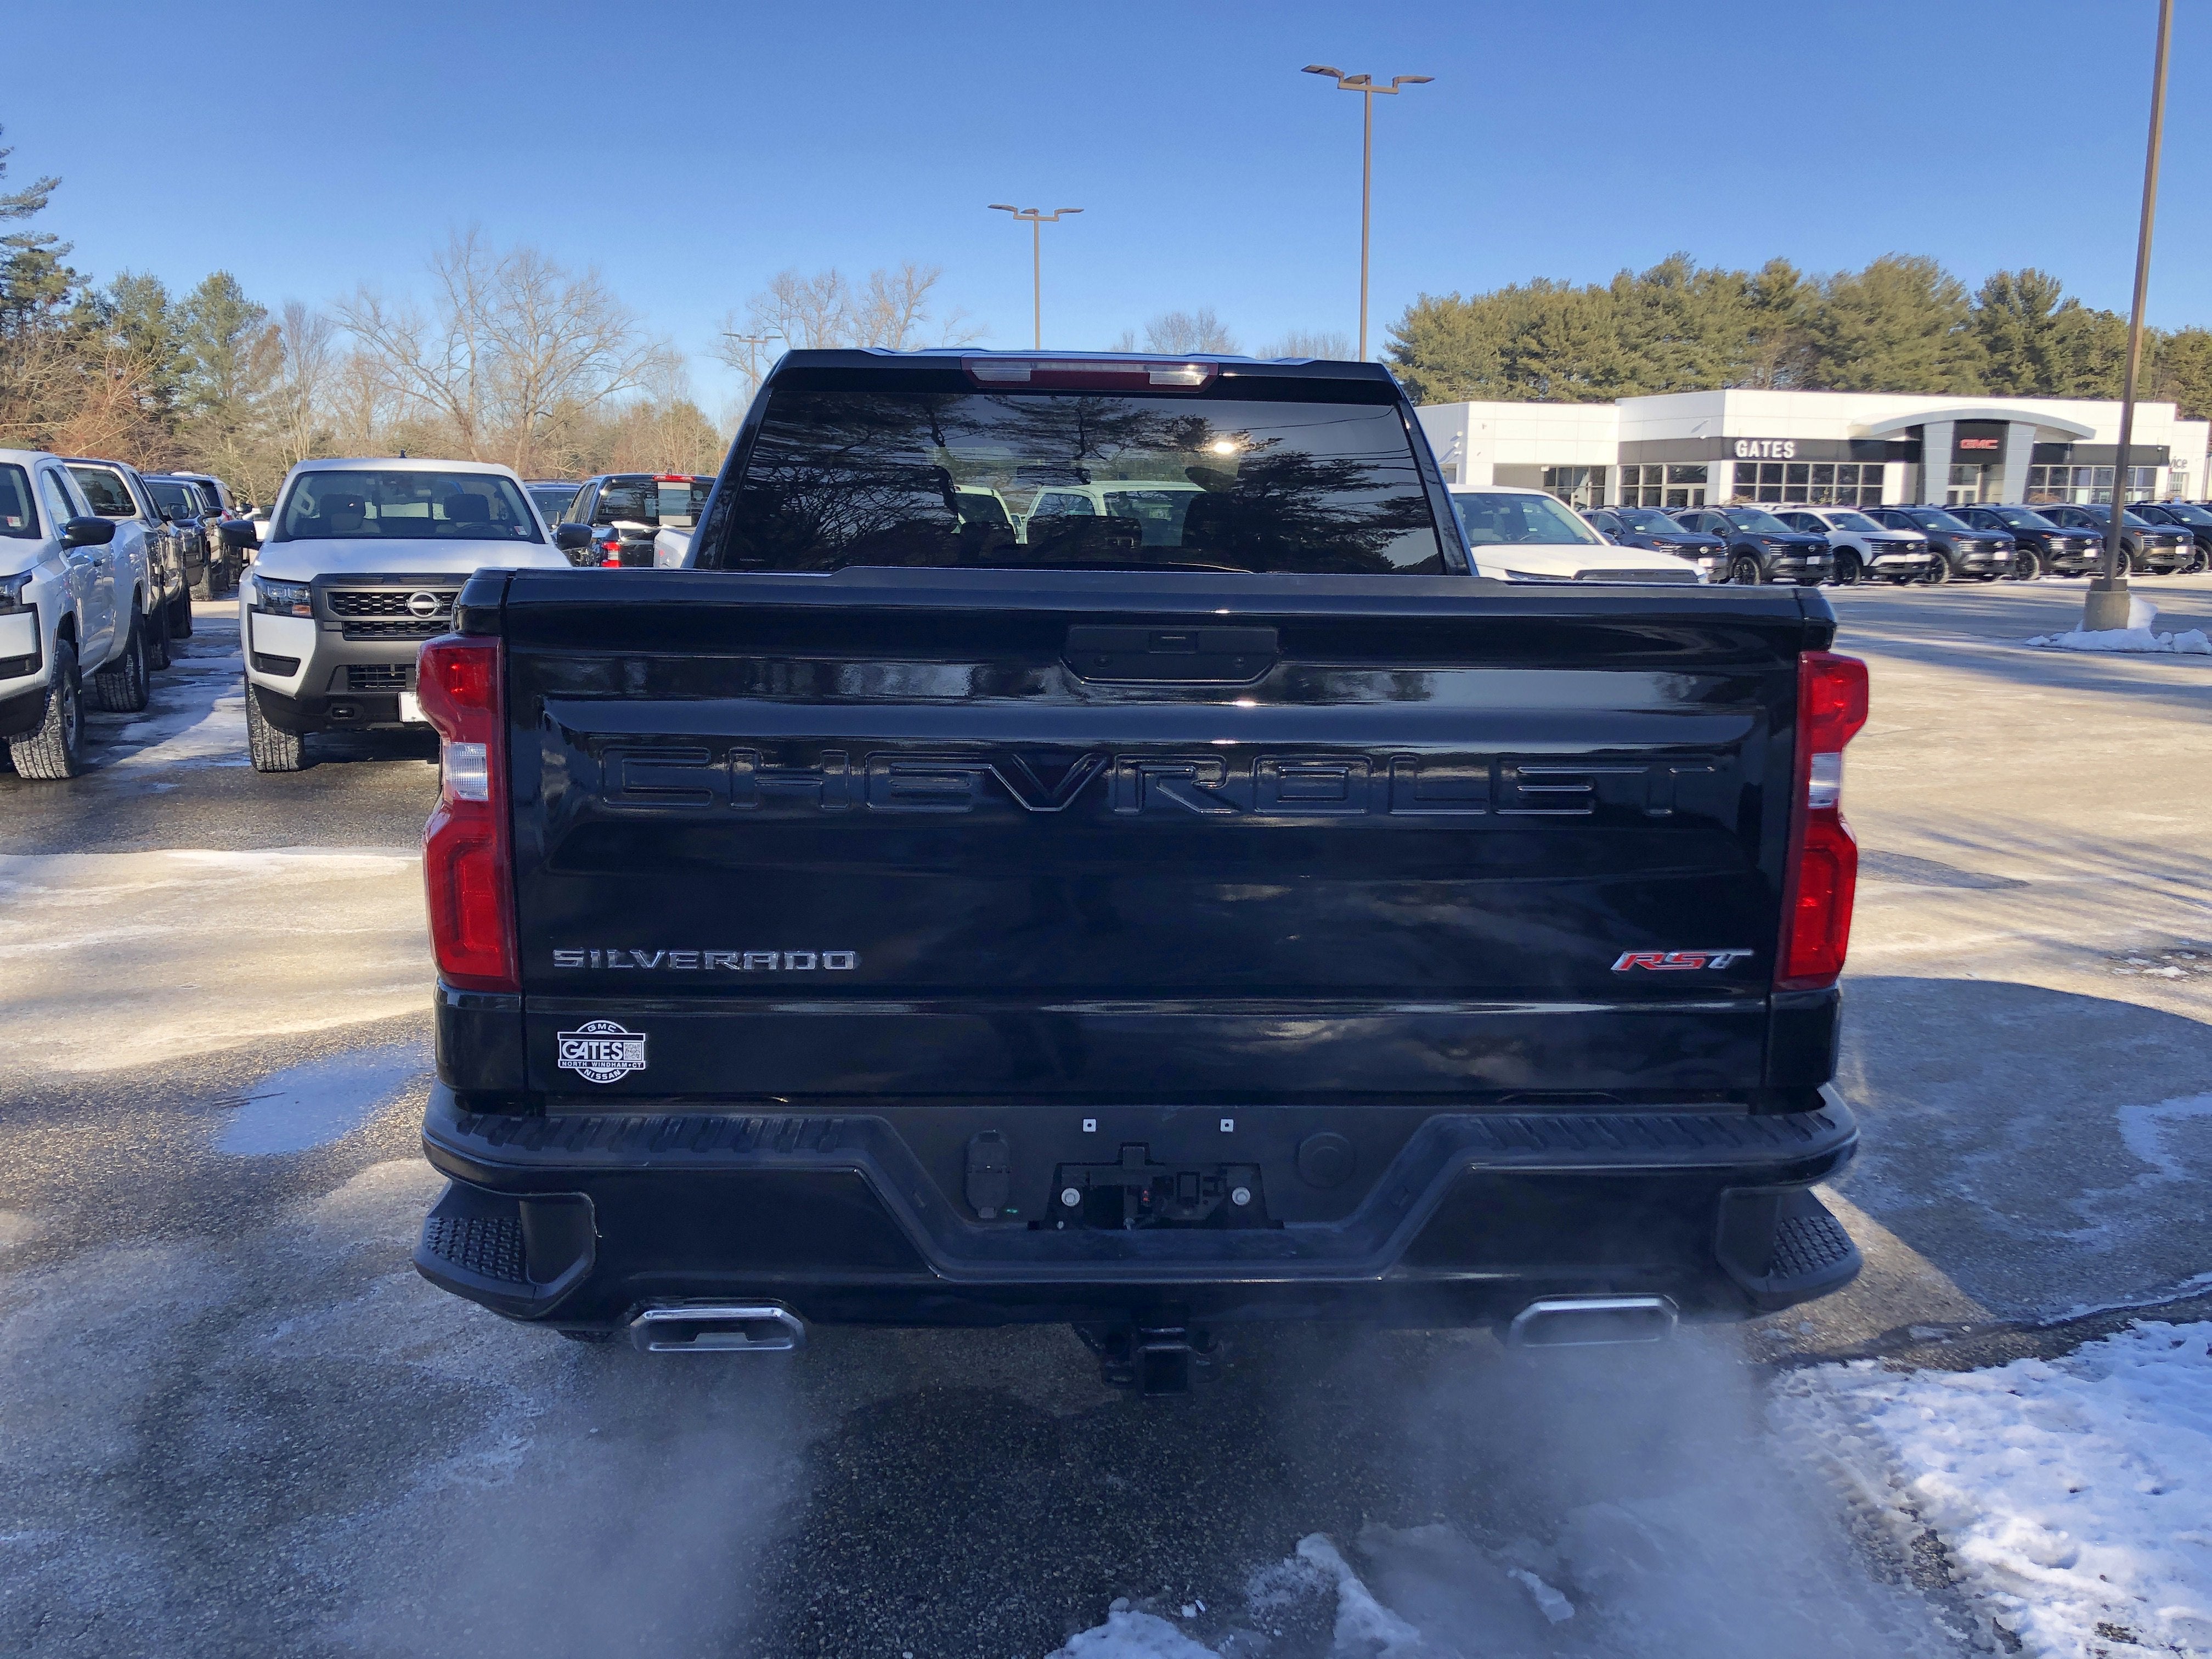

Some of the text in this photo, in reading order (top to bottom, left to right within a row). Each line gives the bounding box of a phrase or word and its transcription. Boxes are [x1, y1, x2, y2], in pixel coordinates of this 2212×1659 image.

[1734, 439, 1796, 459] GATES
[1960, 439, 1999, 449] GMC
[600, 745, 1720, 816] CHEVROLET
[552, 949, 856, 970] SILVERADO
[1610, 950, 1754, 970] RST
[587, 1023, 617, 1032] GMC
[562, 1041, 623, 1060] GATES
[584, 1069, 621, 1080] NISSAN
